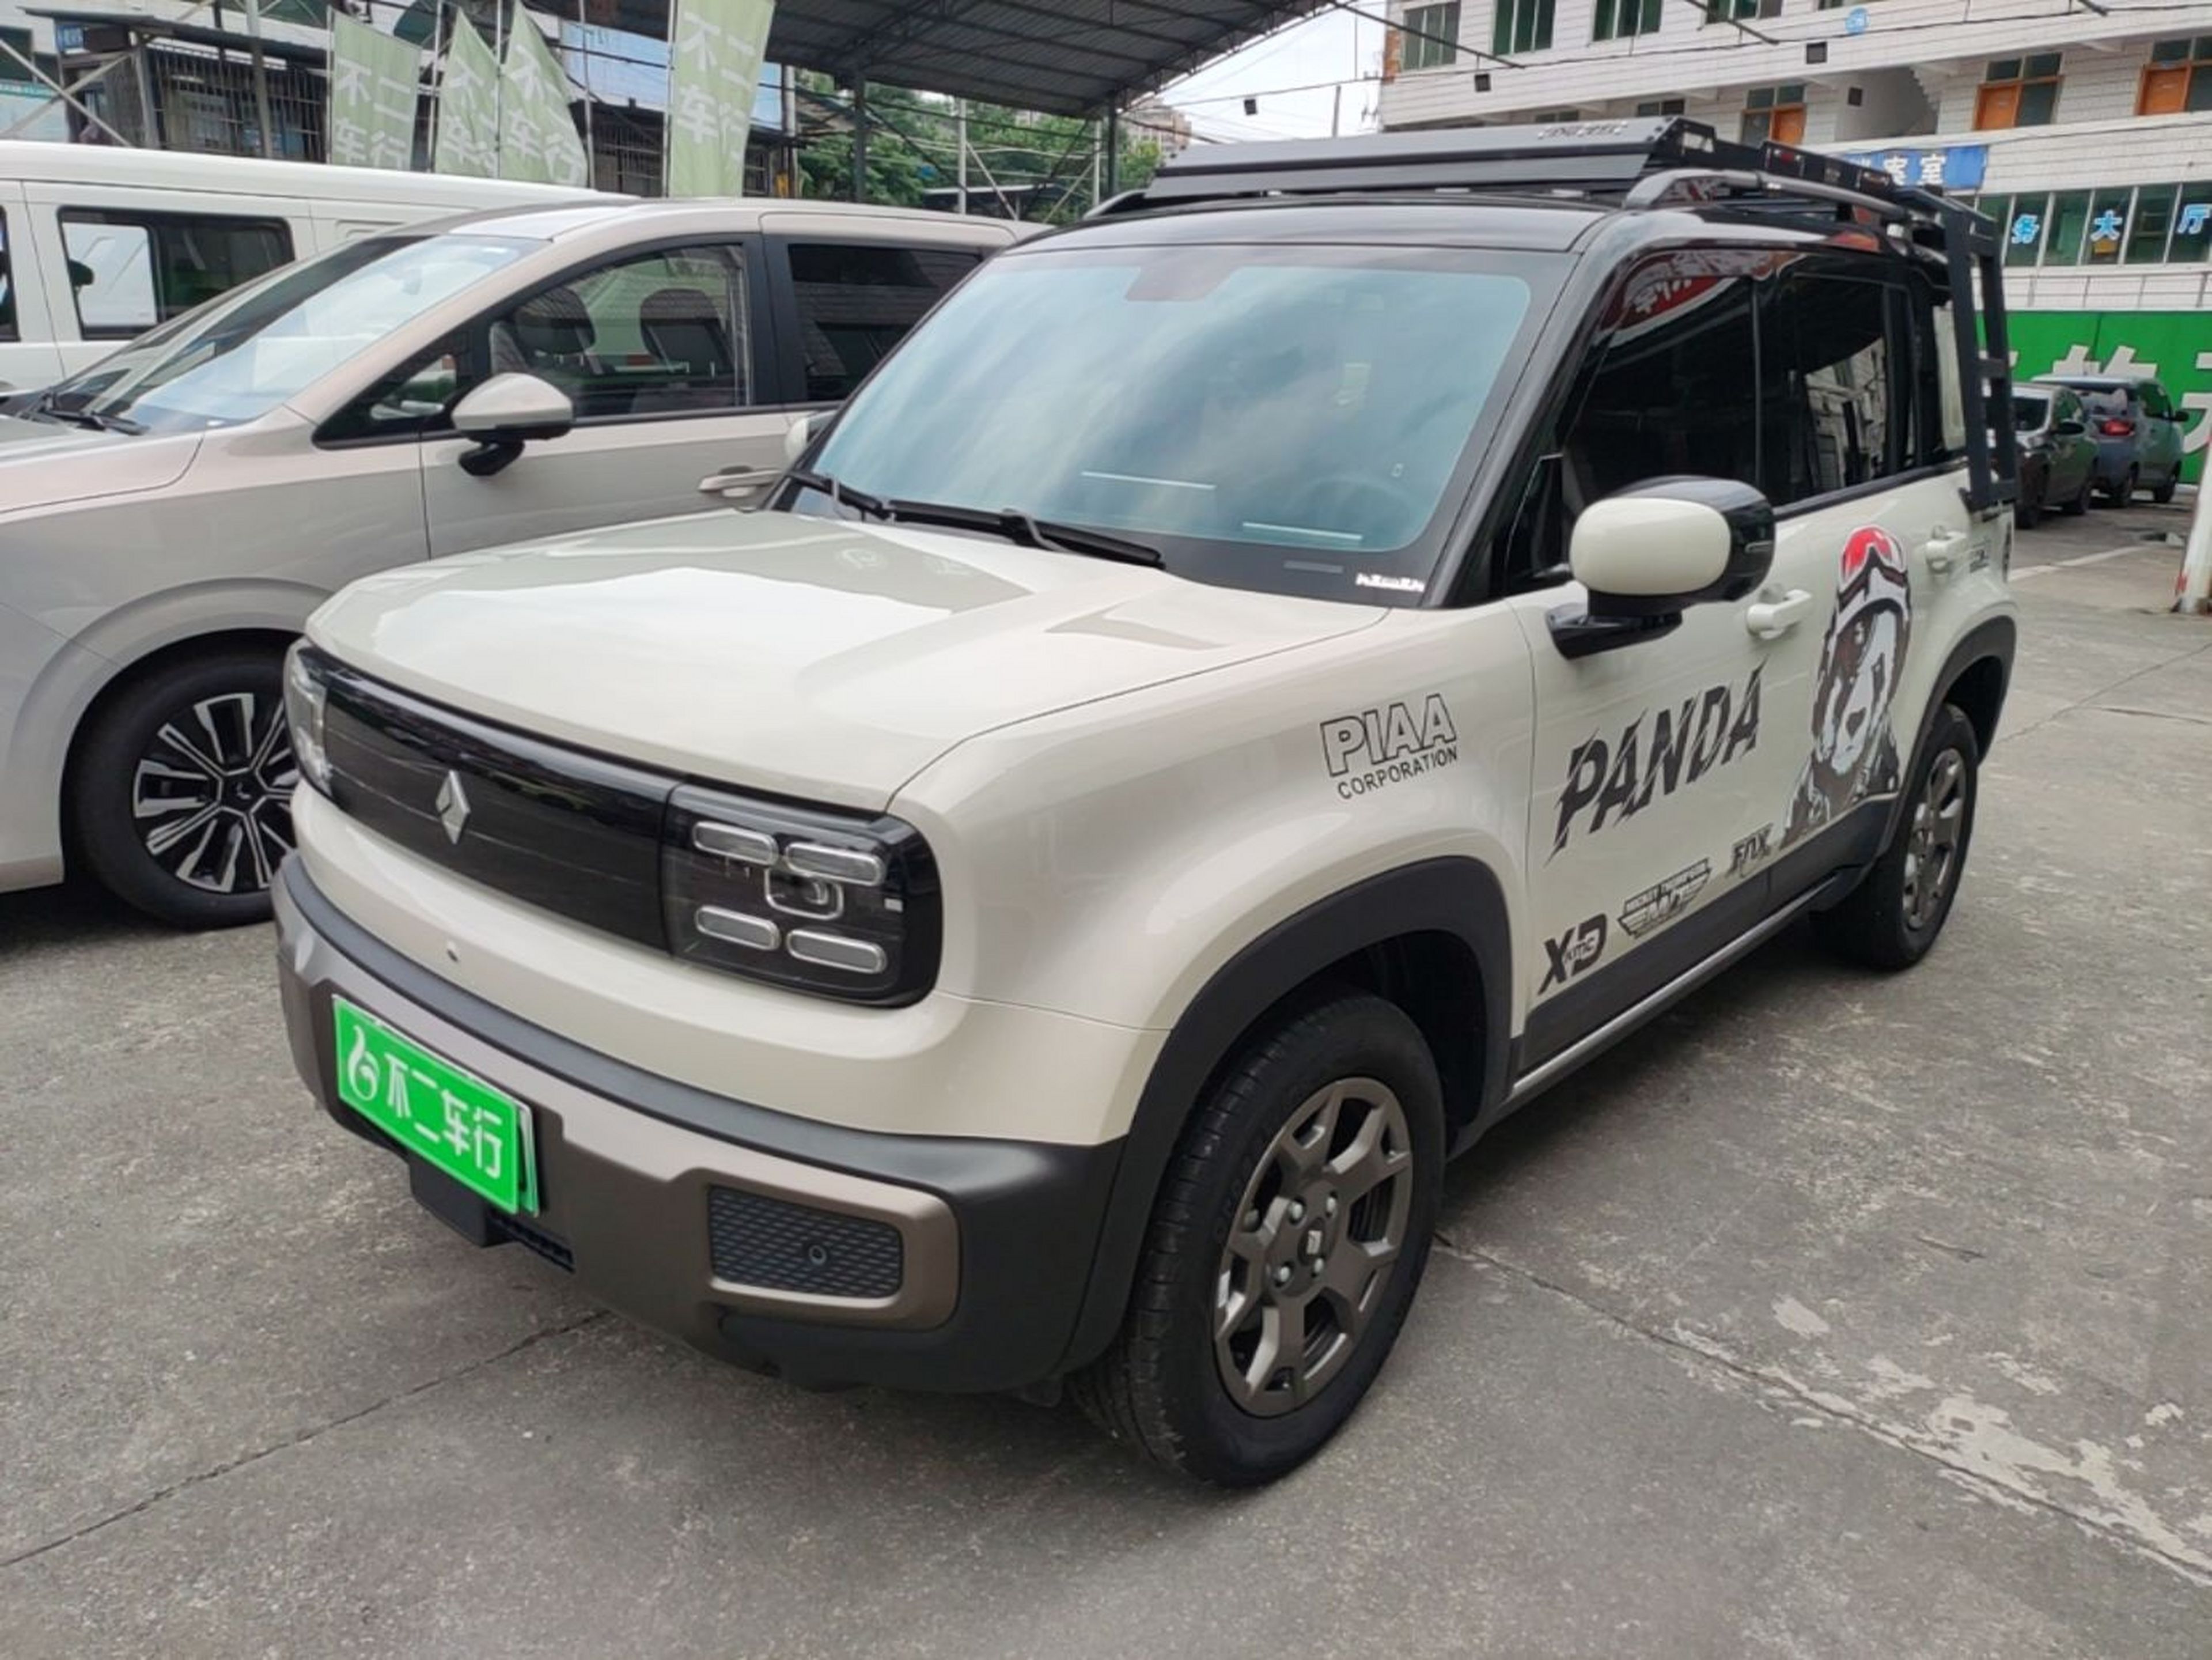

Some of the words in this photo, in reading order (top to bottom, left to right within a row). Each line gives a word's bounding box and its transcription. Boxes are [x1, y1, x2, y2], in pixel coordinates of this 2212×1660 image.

[334, 58, 412, 123] 不二
[1320, 693, 1457, 777] PIAA
[1338, 746, 1457, 799] CORPORATION
[1544, 655, 1768, 865] PANDA
[384, 1052, 502, 1179] 不二车行
